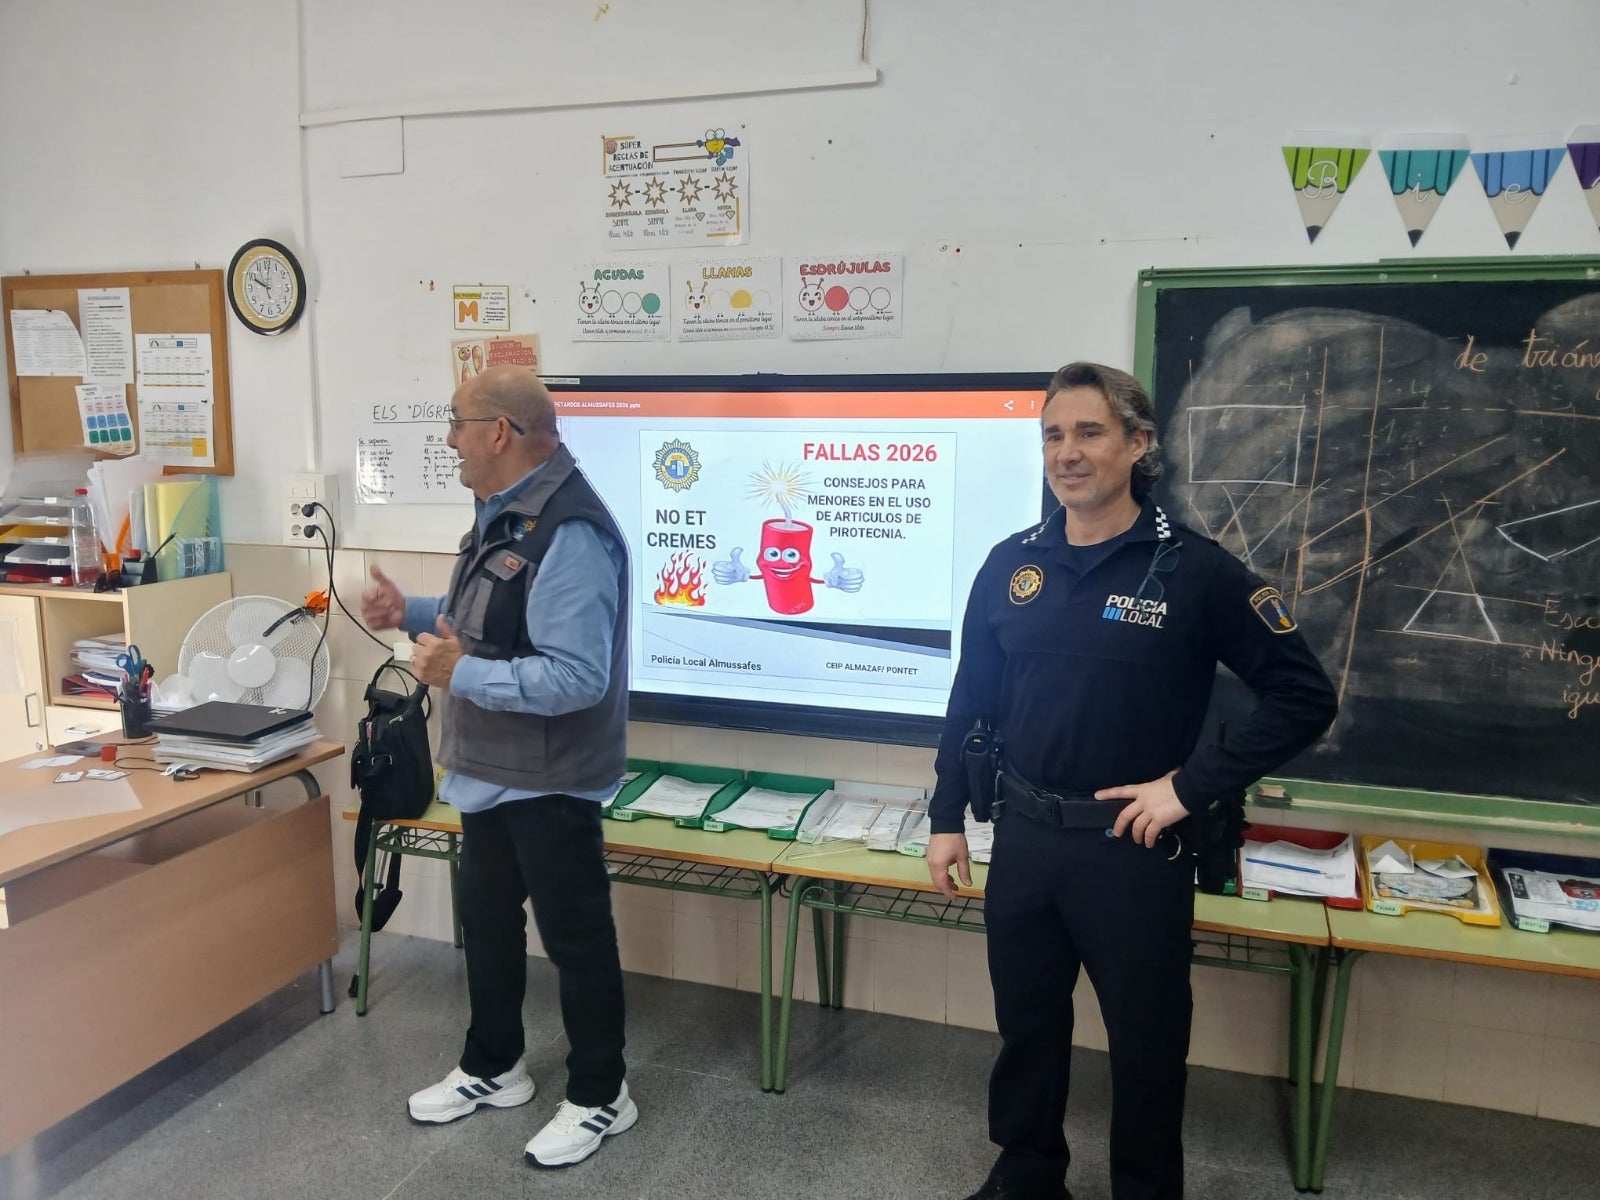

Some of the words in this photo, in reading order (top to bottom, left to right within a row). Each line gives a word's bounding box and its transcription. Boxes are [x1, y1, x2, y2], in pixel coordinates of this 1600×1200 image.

[639, 151, 649, 159] DE
[608, 161, 654, 172] ACENTUACIÓN
[594, 268, 645, 281] AGUDAS
[703, 266, 753, 279] LLANAS
[800, 260, 891, 276] ESDRÚJULAS
[459, 301, 479, 323] M
[1455, 334, 1488, 372] de
[373, 404, 397, 421] ELS
[412, 401, 450, 420] DÍGRA
[803, 443, 880, 461] FALLAS
[886, 444, 938, 462] 2026
[823, 477, 888, 489] CONSEJOS
[891, 479, 926, 490] PARA
[807, 495, 865, 507] MENORES
[868, 497, 885, 507] EN
[888, 497, 902, 508] EL
[905, 498, 931, 508] USO
[656, 509, 681, 525] NO
[685, 511, 706, 526] ET
[816, 511, 831, 521] DE
[834, 512, 902, 524] ARTICULOS
[906, 517, 922, 525] DE
[646, 532, 716, 550] CREMES
[829, 527, 906, 540] PIROTECNIA.
[1120, 609, 1164, 629] LOCAL
[651, 655, 681, 666] Policía
[683, 657, 706, 668] Local
[708, 659, 762, 672] Almussafes
[825, 662, 843, 670] CEIP
[844, 664, 884, 674] ALMAZAF/
[886, 667, 919, 676] PONTET
